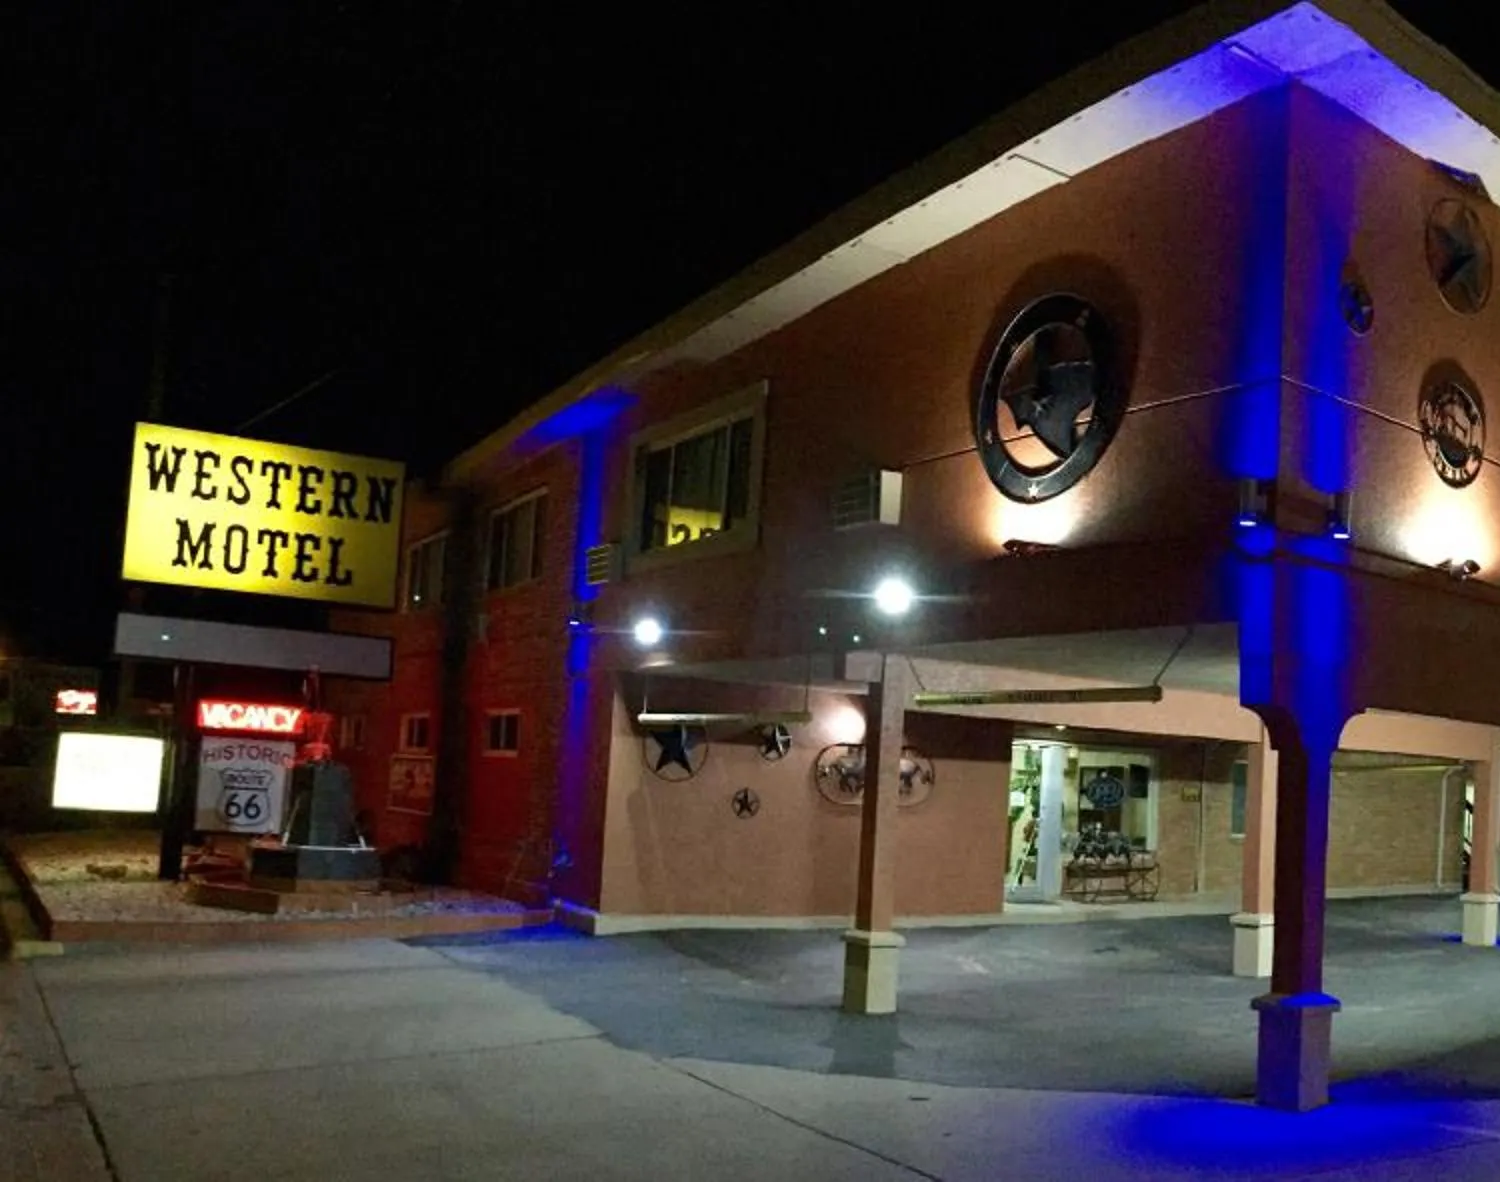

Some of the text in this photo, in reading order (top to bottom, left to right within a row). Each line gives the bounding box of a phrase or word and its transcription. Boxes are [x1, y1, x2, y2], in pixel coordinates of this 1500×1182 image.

[144, 441, 396, 524] WESTERN
[171, 517, 353, 586] MOTEL
[200, 702, 302, 733] VACANCY
[202, 743, 293, 767] HISTORIC
[223, 793, 261, 820] 66
